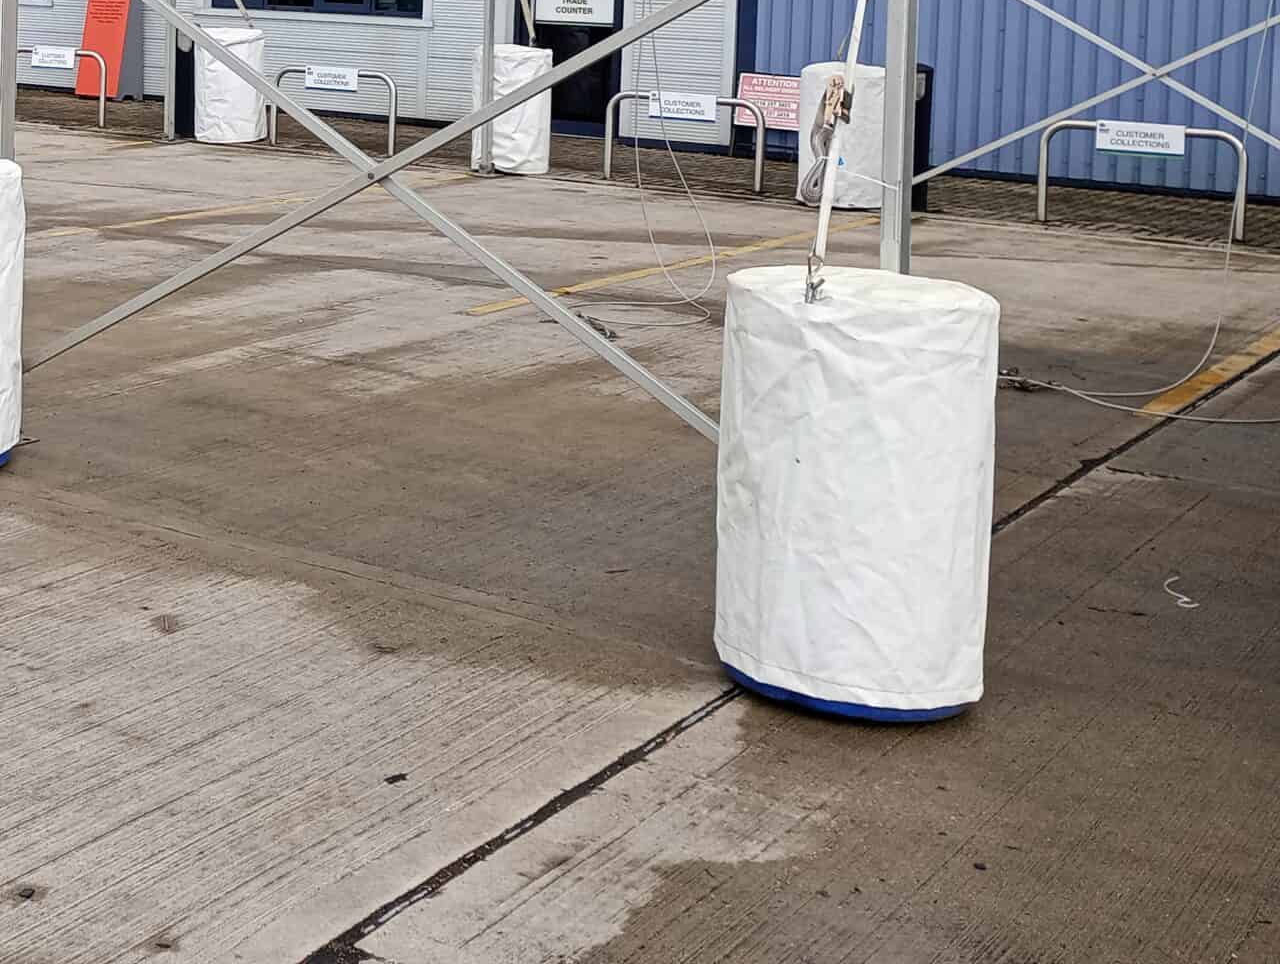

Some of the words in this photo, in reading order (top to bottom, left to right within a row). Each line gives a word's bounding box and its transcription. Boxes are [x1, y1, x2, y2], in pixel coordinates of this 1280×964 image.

[555, 6, 593, 15] COUNTER
[752, 78, 799, 88] ATTENTION
[663, 99, 702, 108] CUSTOMER
[1115, 130, 1165, 140] CUSTOMER
[1110, 138, 1171, 149] COLLECTIONS
